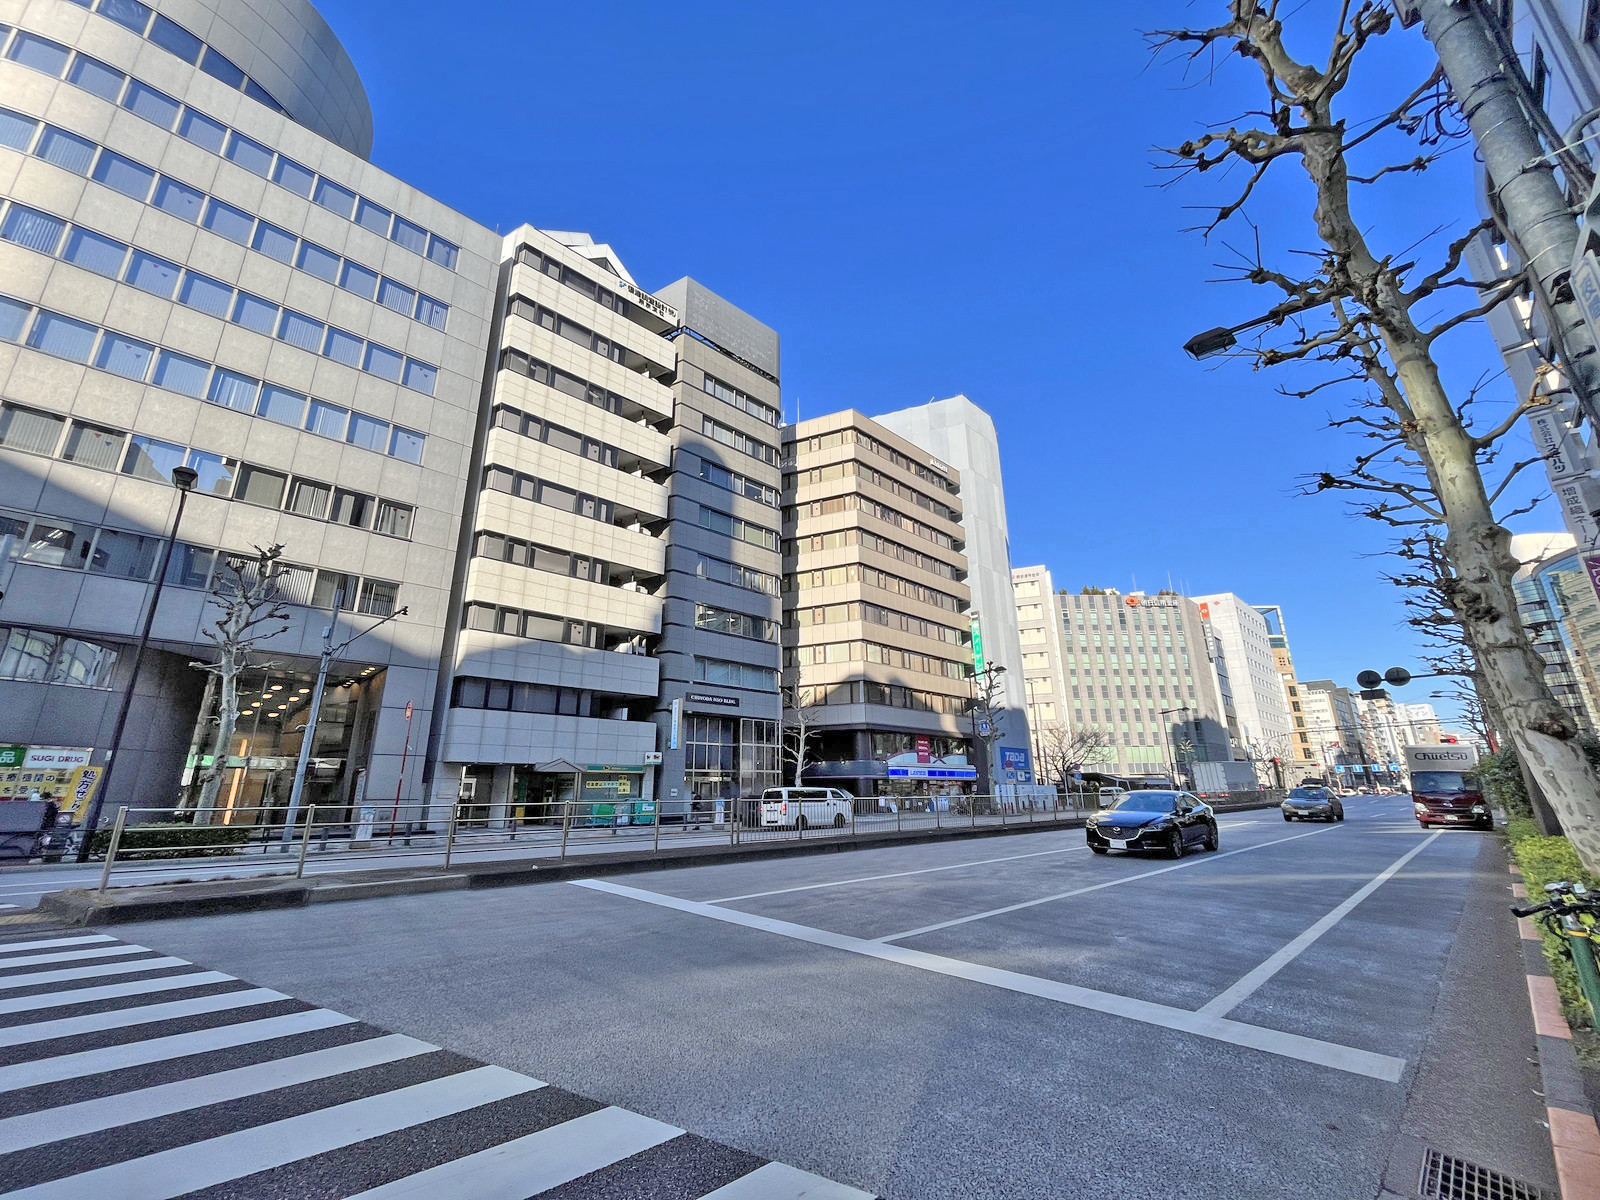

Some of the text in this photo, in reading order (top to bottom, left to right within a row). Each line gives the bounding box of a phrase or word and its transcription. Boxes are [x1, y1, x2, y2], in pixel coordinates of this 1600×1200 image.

[1537, 418, 1566, 473] 株式会社スハツ
[690, 694, 713, 702] CHIYODA
[57, 755, 84, 763] DRUG
